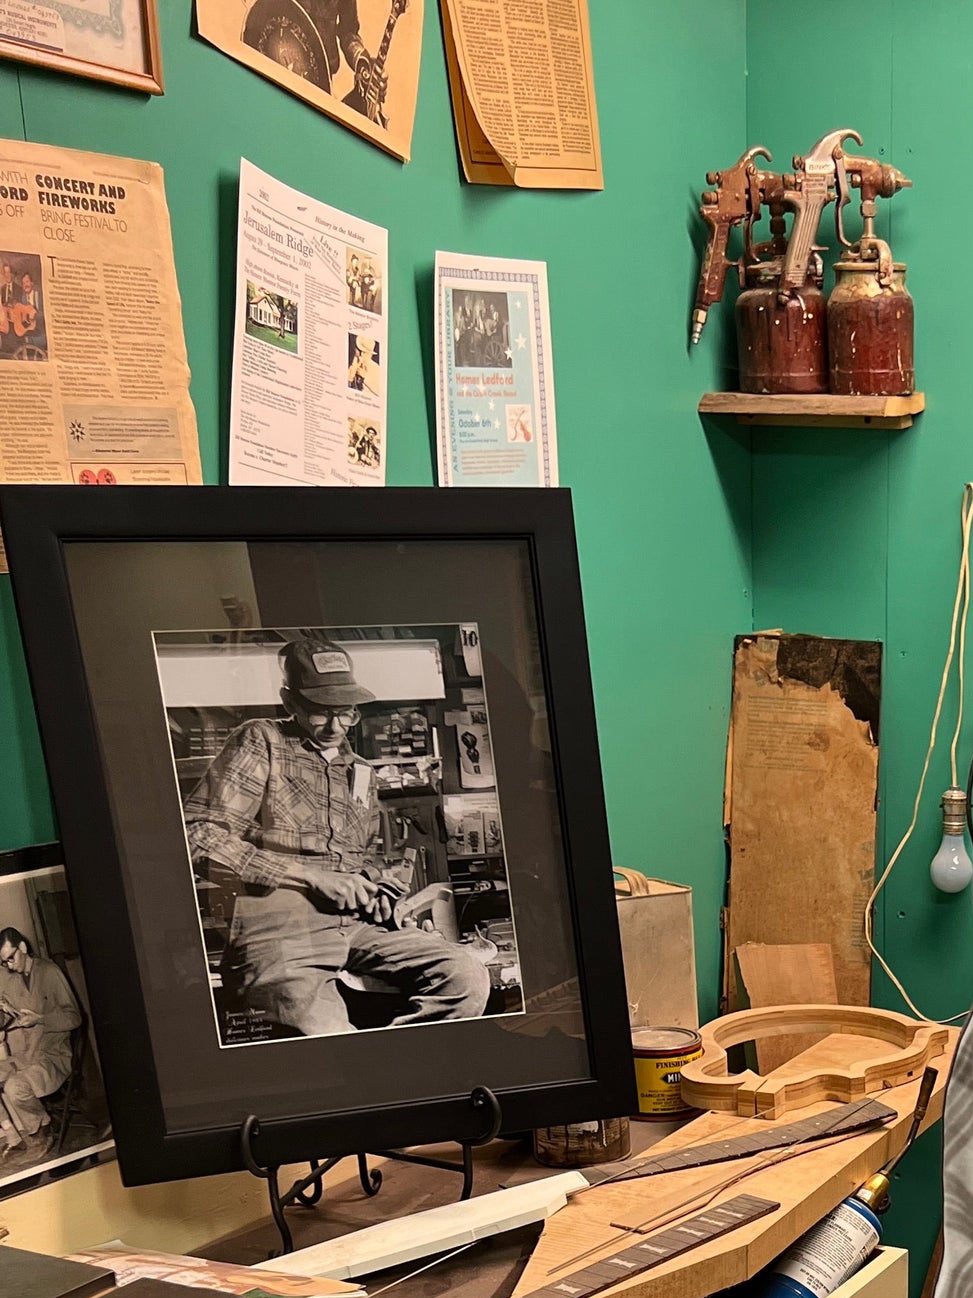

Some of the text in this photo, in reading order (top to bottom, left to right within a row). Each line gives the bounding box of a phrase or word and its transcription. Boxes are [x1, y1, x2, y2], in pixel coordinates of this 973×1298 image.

[35, 174, 95, 196] CONCERT
[98, 184, 126, 200] AND
[6, 204, 25, 218] OFF
[38, 191, 116, 215] FIREWORKS
[41, 209, 128, 233] BRING FESTIVAL TO
[43, 226, 76, 243] CLOSE
[244, 210, 284, 244] Jerusalem
[286, 233, 313, 258] Ridge
[482, 373, 514, 385] Ledford
[462, 630, 478, 647] 10
